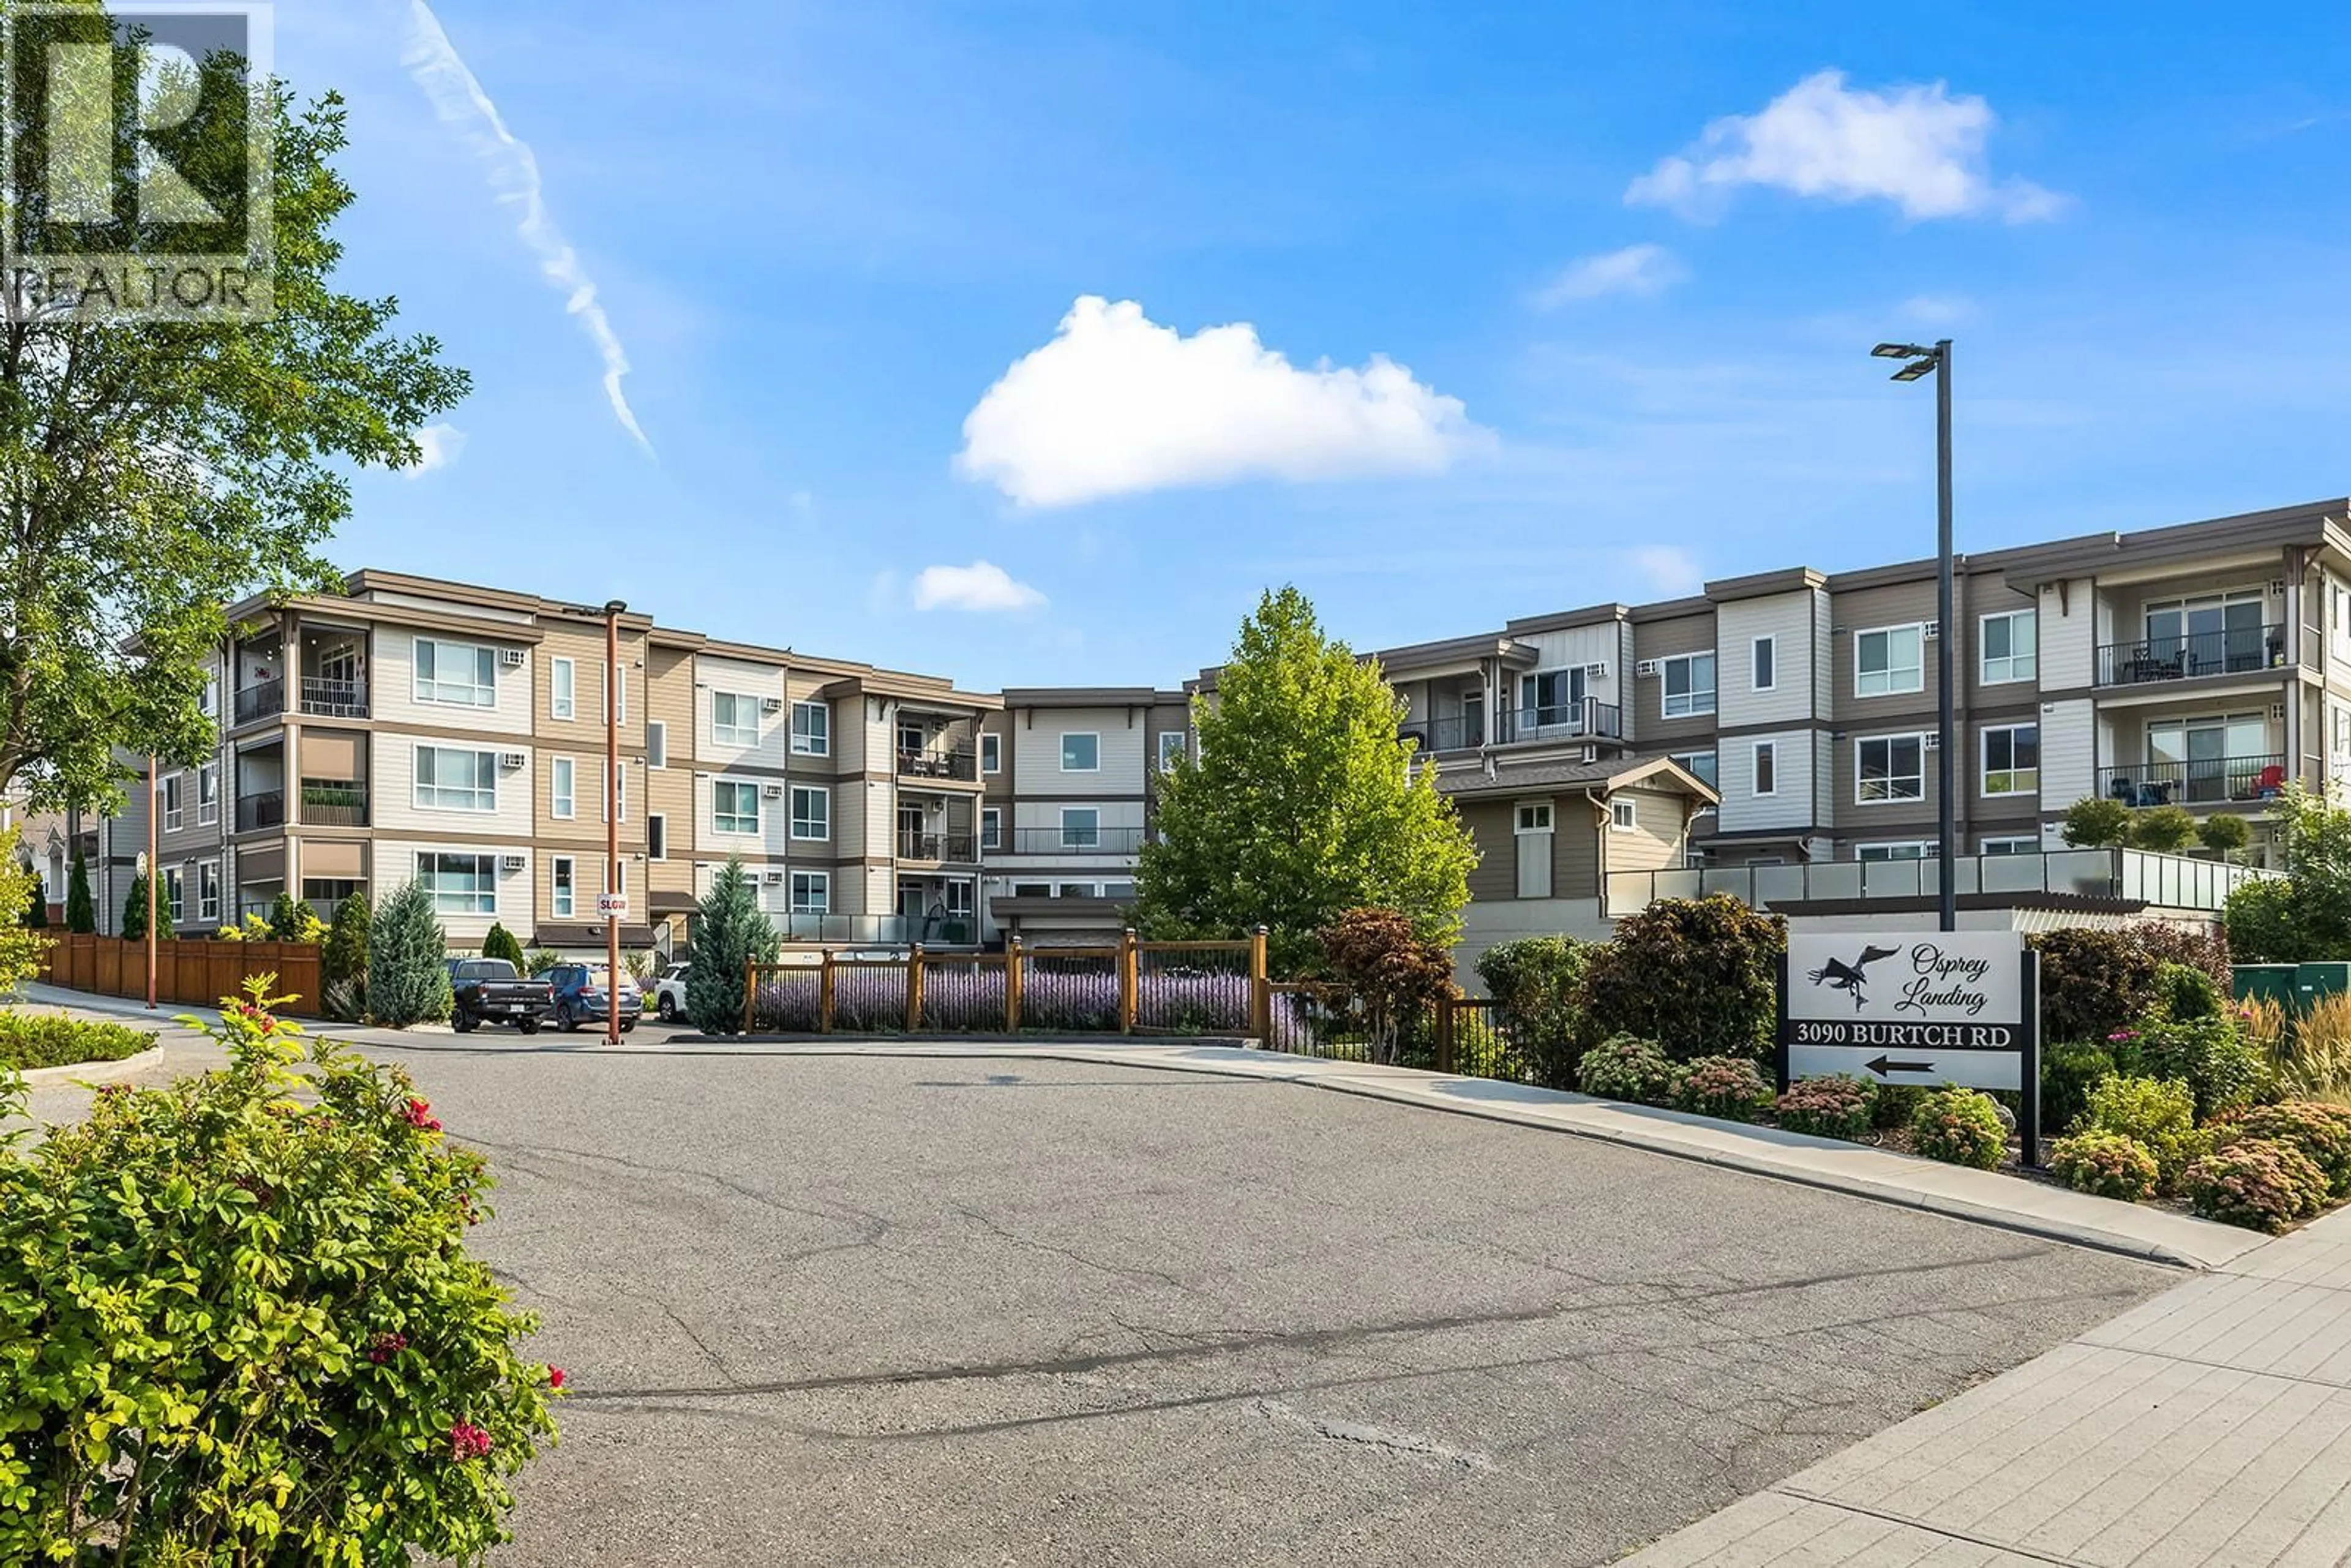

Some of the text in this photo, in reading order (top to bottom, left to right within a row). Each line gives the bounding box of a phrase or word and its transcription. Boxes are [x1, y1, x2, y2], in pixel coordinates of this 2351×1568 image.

[1911, 943, 1990, 983] Osprey
[1894, 977, 1988, 1017] Landing
[1798, 1023, 2011, 1047] 3090 BURTCH RD
